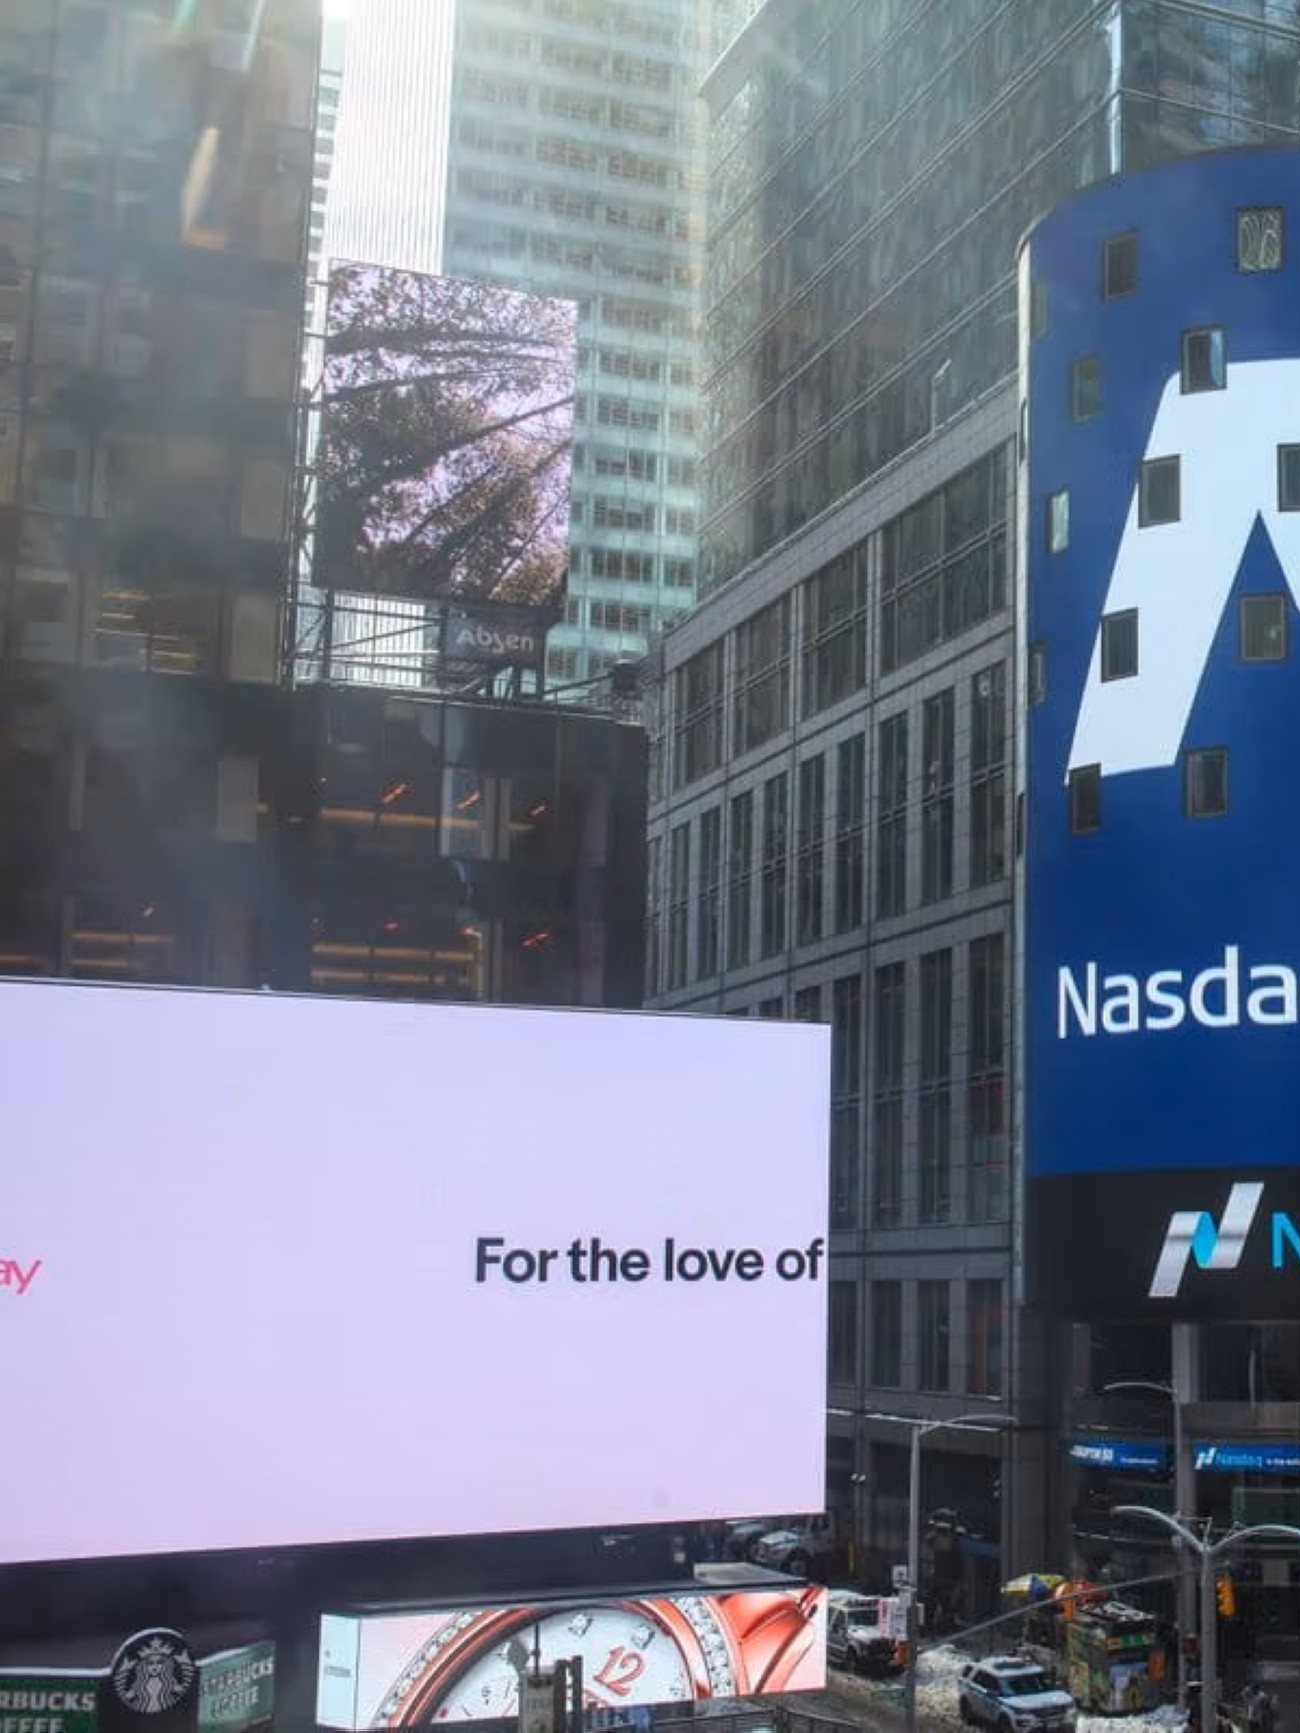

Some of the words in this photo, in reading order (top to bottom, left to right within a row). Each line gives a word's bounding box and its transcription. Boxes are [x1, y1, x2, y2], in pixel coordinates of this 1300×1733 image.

[456, 625, 535, 654] Absen
[476, 1238, 558, 1283] For
[567, 1237, 651, 1283] the
[664, 1237, 764, 1282] love
[775, 1238, 824, 1283] of
